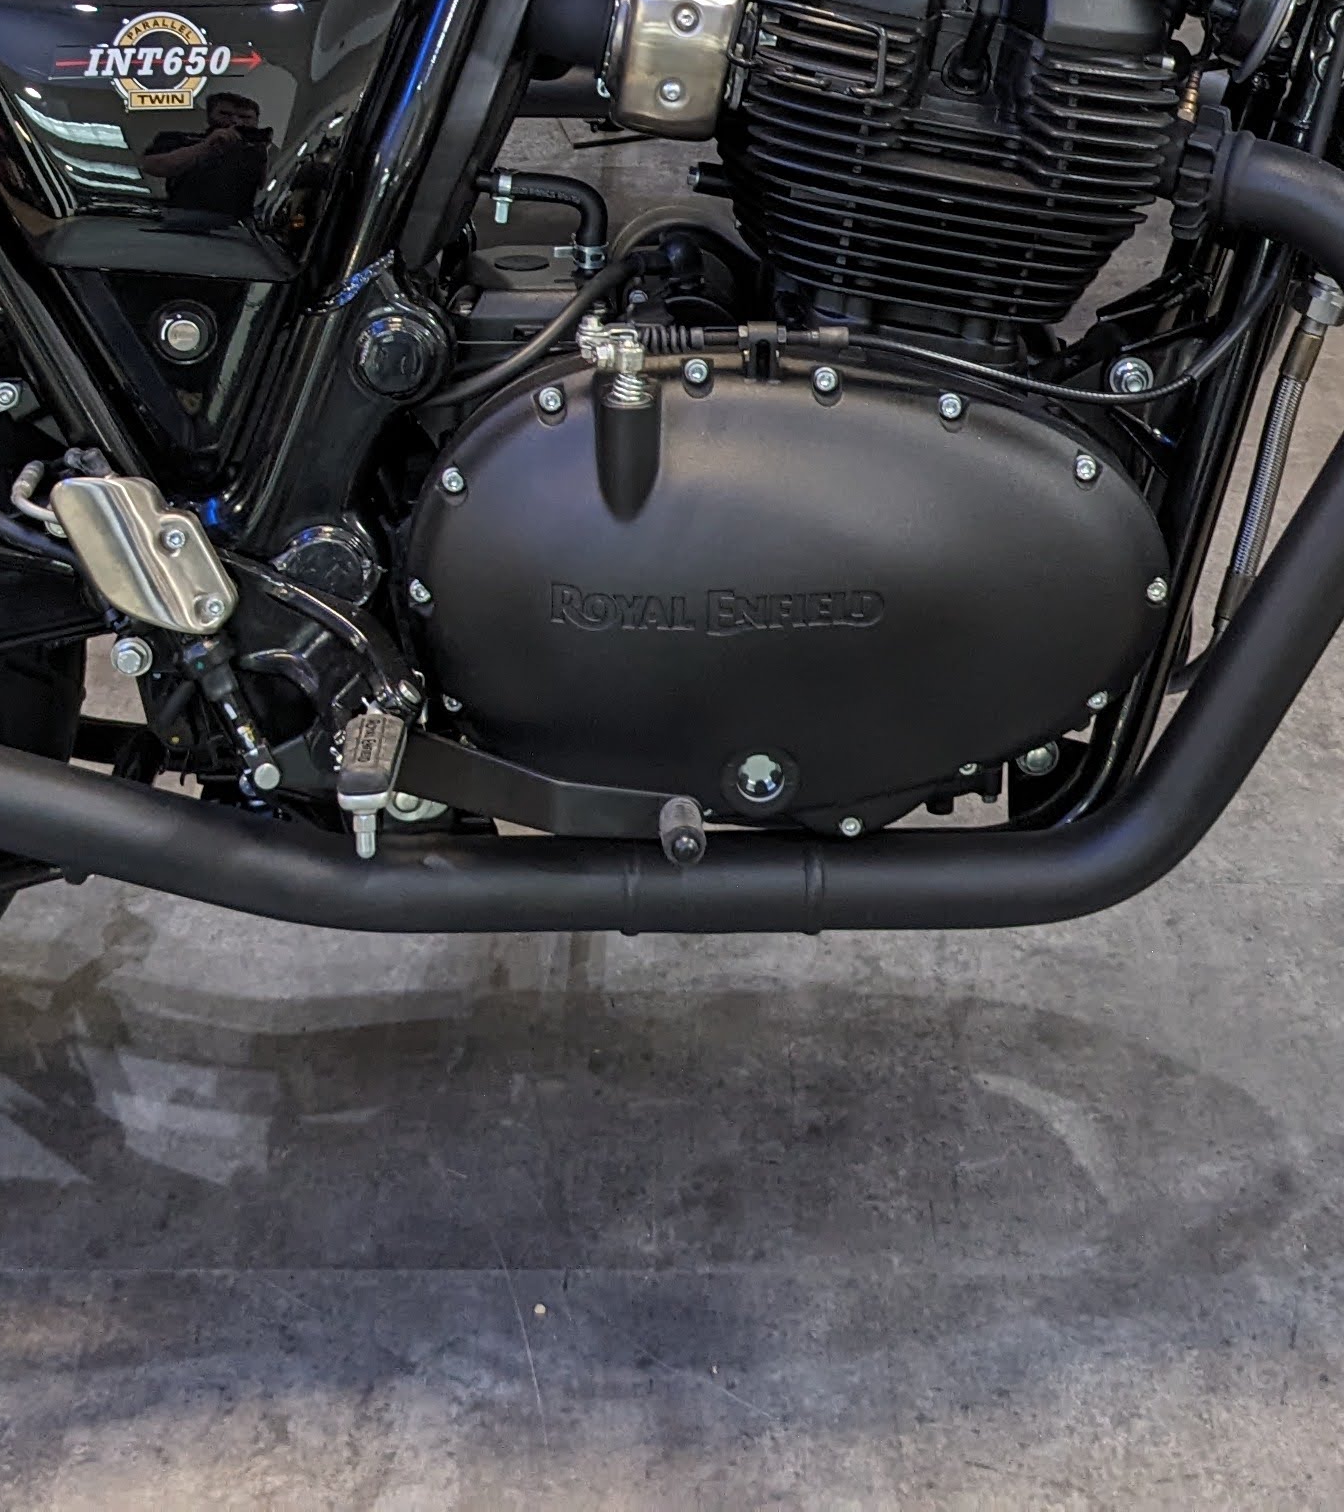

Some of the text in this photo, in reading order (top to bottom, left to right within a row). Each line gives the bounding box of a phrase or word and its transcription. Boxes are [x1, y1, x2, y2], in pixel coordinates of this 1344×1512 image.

[126, 18, 193, 41] PARALLEL
[83, 45, 231, 77] INT650
[137, 94, 185, 105] TWIN
[551, 583, 886, 636] ROYAL ENFIELD
